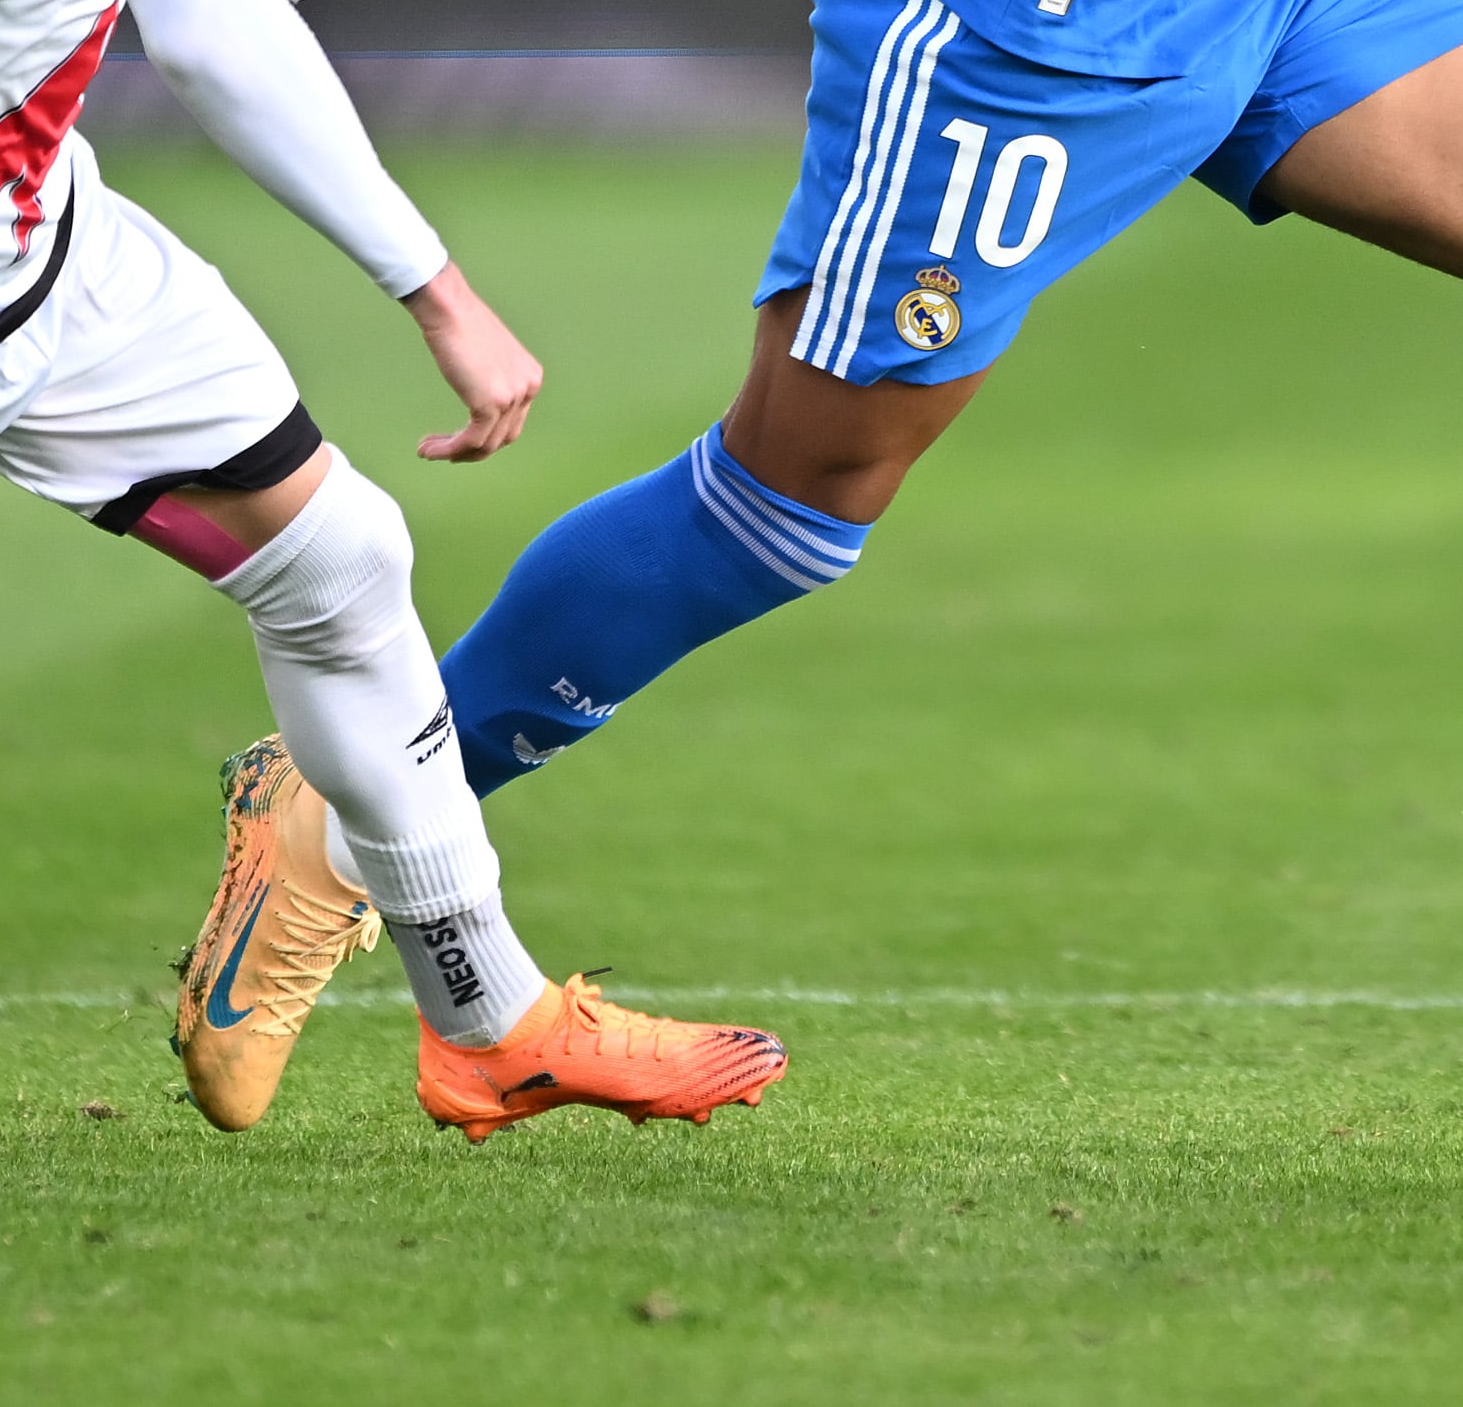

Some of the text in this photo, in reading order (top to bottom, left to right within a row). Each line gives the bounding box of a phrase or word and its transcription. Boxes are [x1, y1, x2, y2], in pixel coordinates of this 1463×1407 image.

[928, 117, 1069, 268] 10
[550, 676, 619, 718] RM
[436, 948, 484, 1008] NEO
